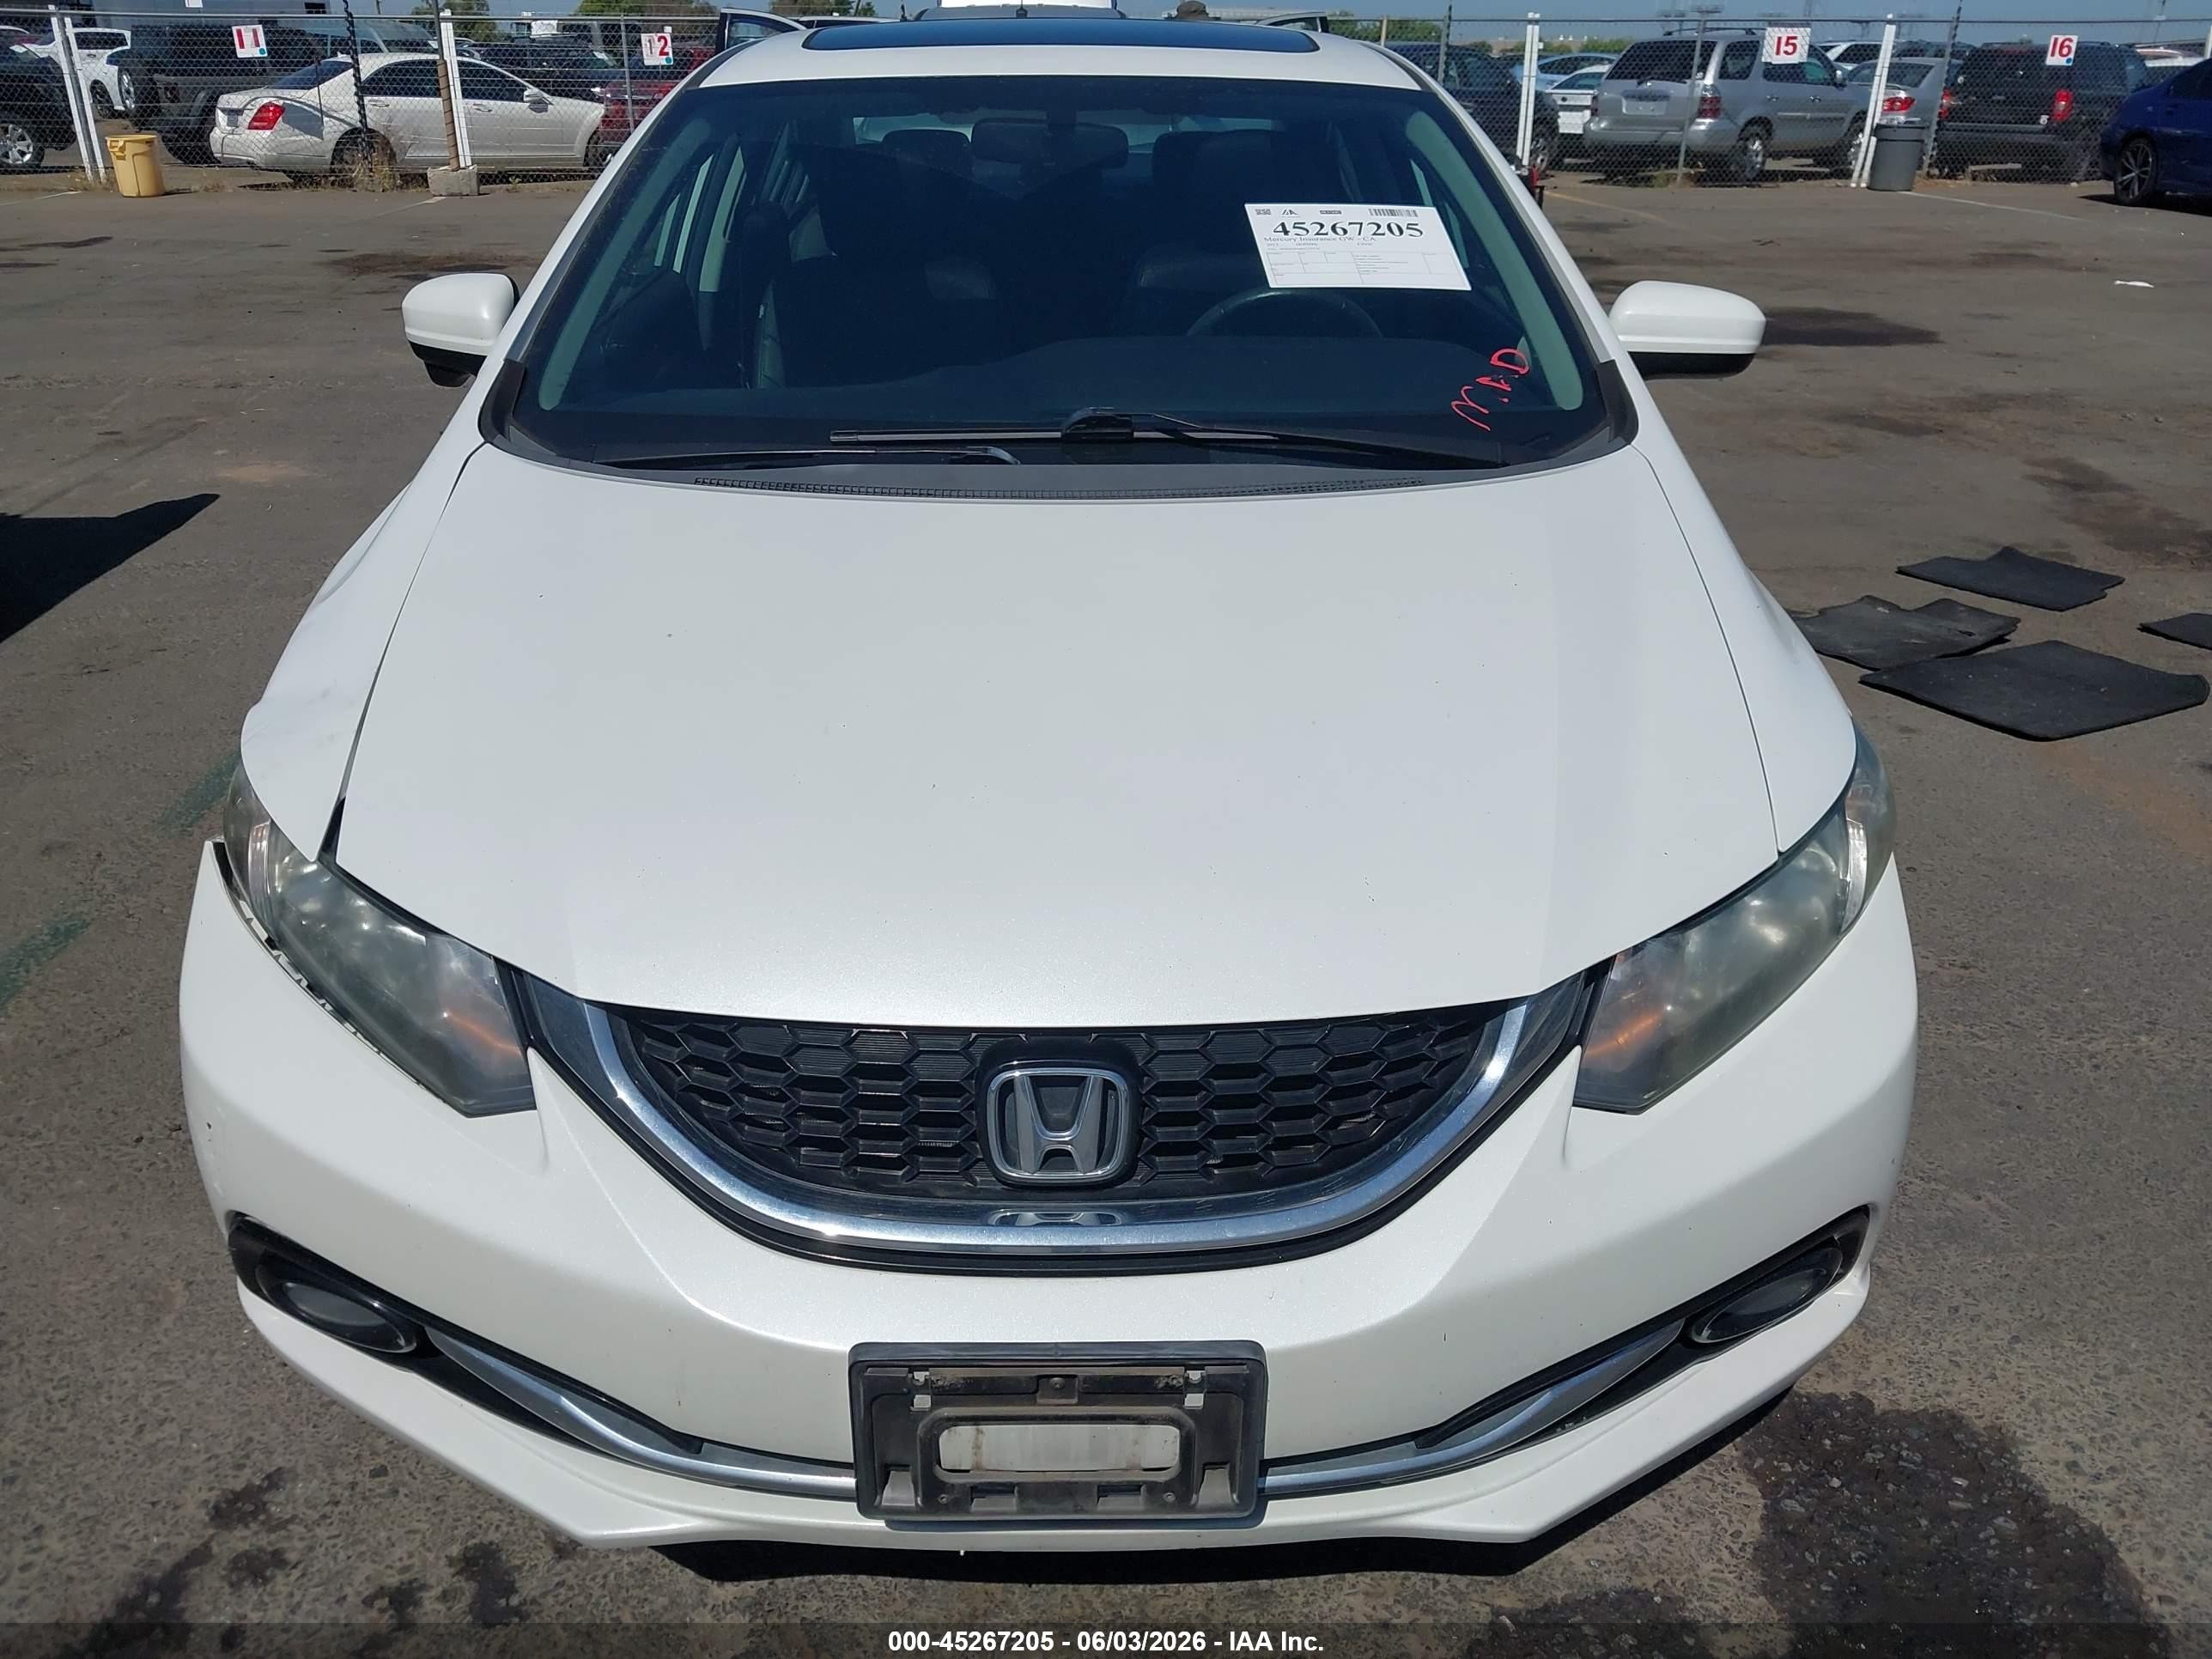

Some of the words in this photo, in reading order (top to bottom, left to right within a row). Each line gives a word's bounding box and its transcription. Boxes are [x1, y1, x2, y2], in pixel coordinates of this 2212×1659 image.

[647, 35, 670, 56] 12
[1775, 35, 1798, 56] 15
[2051, 37, 2074, 58] 16
[1272, 221, 1424, 238] 45267205
